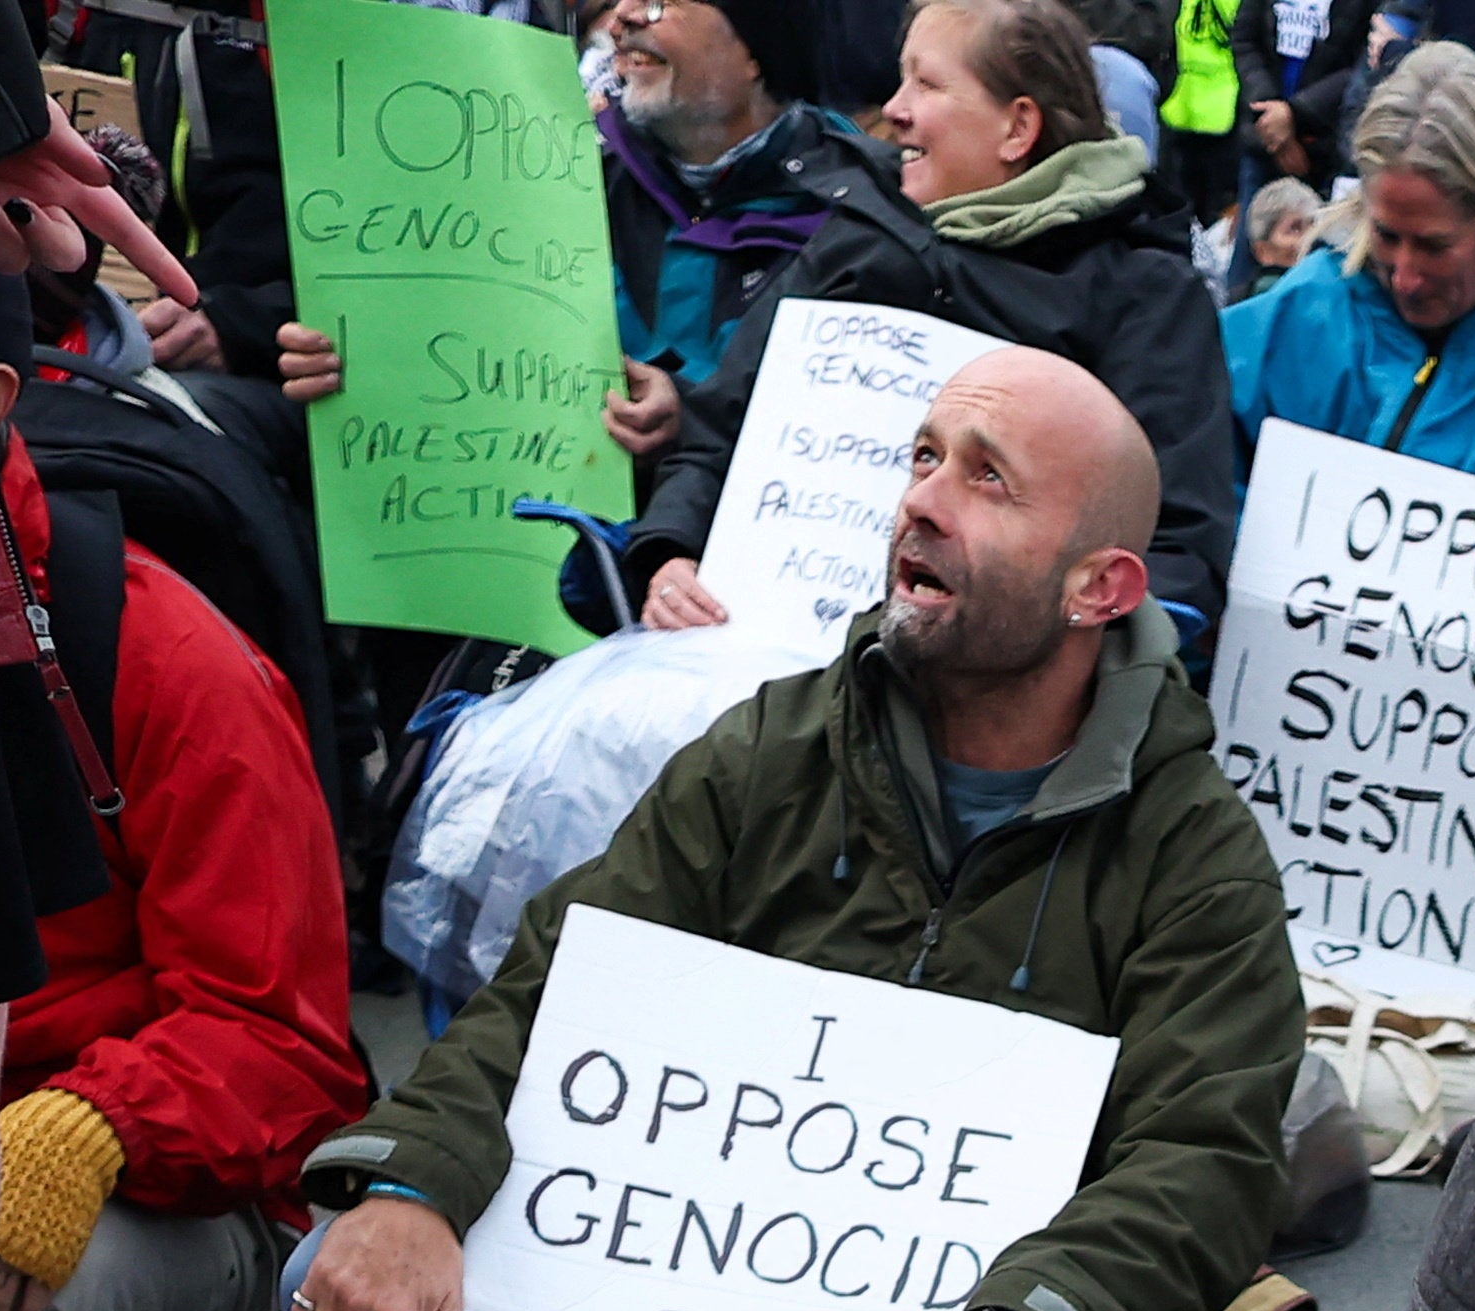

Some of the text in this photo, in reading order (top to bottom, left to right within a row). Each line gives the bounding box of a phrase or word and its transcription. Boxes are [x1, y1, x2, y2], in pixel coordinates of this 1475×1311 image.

[336, 59, 597, 192] I OPPOSE
[296, 189, 598, 287] GENOCIDE
[337, 314, 627, 408] I SUPPORT
[801, 309, 930, 352] I OPPOSE
[805, 353, 943, 403] GENOCID
[338, 416, 577, 473] PALESTINE
[778, 423, 914, 473] I SUPPOR
[1295, 470, 1316, 549] I
[777, 546, 885, 596] ACTION
[1229, 647, 1248, 728] I
[1281, 859, 1475, 963] CTION
[792, 1016, 836, 1084] I
[560, 1049, 1013, 1207] OPPOSE
[525, 1168, 982, 1310] GENOCID
